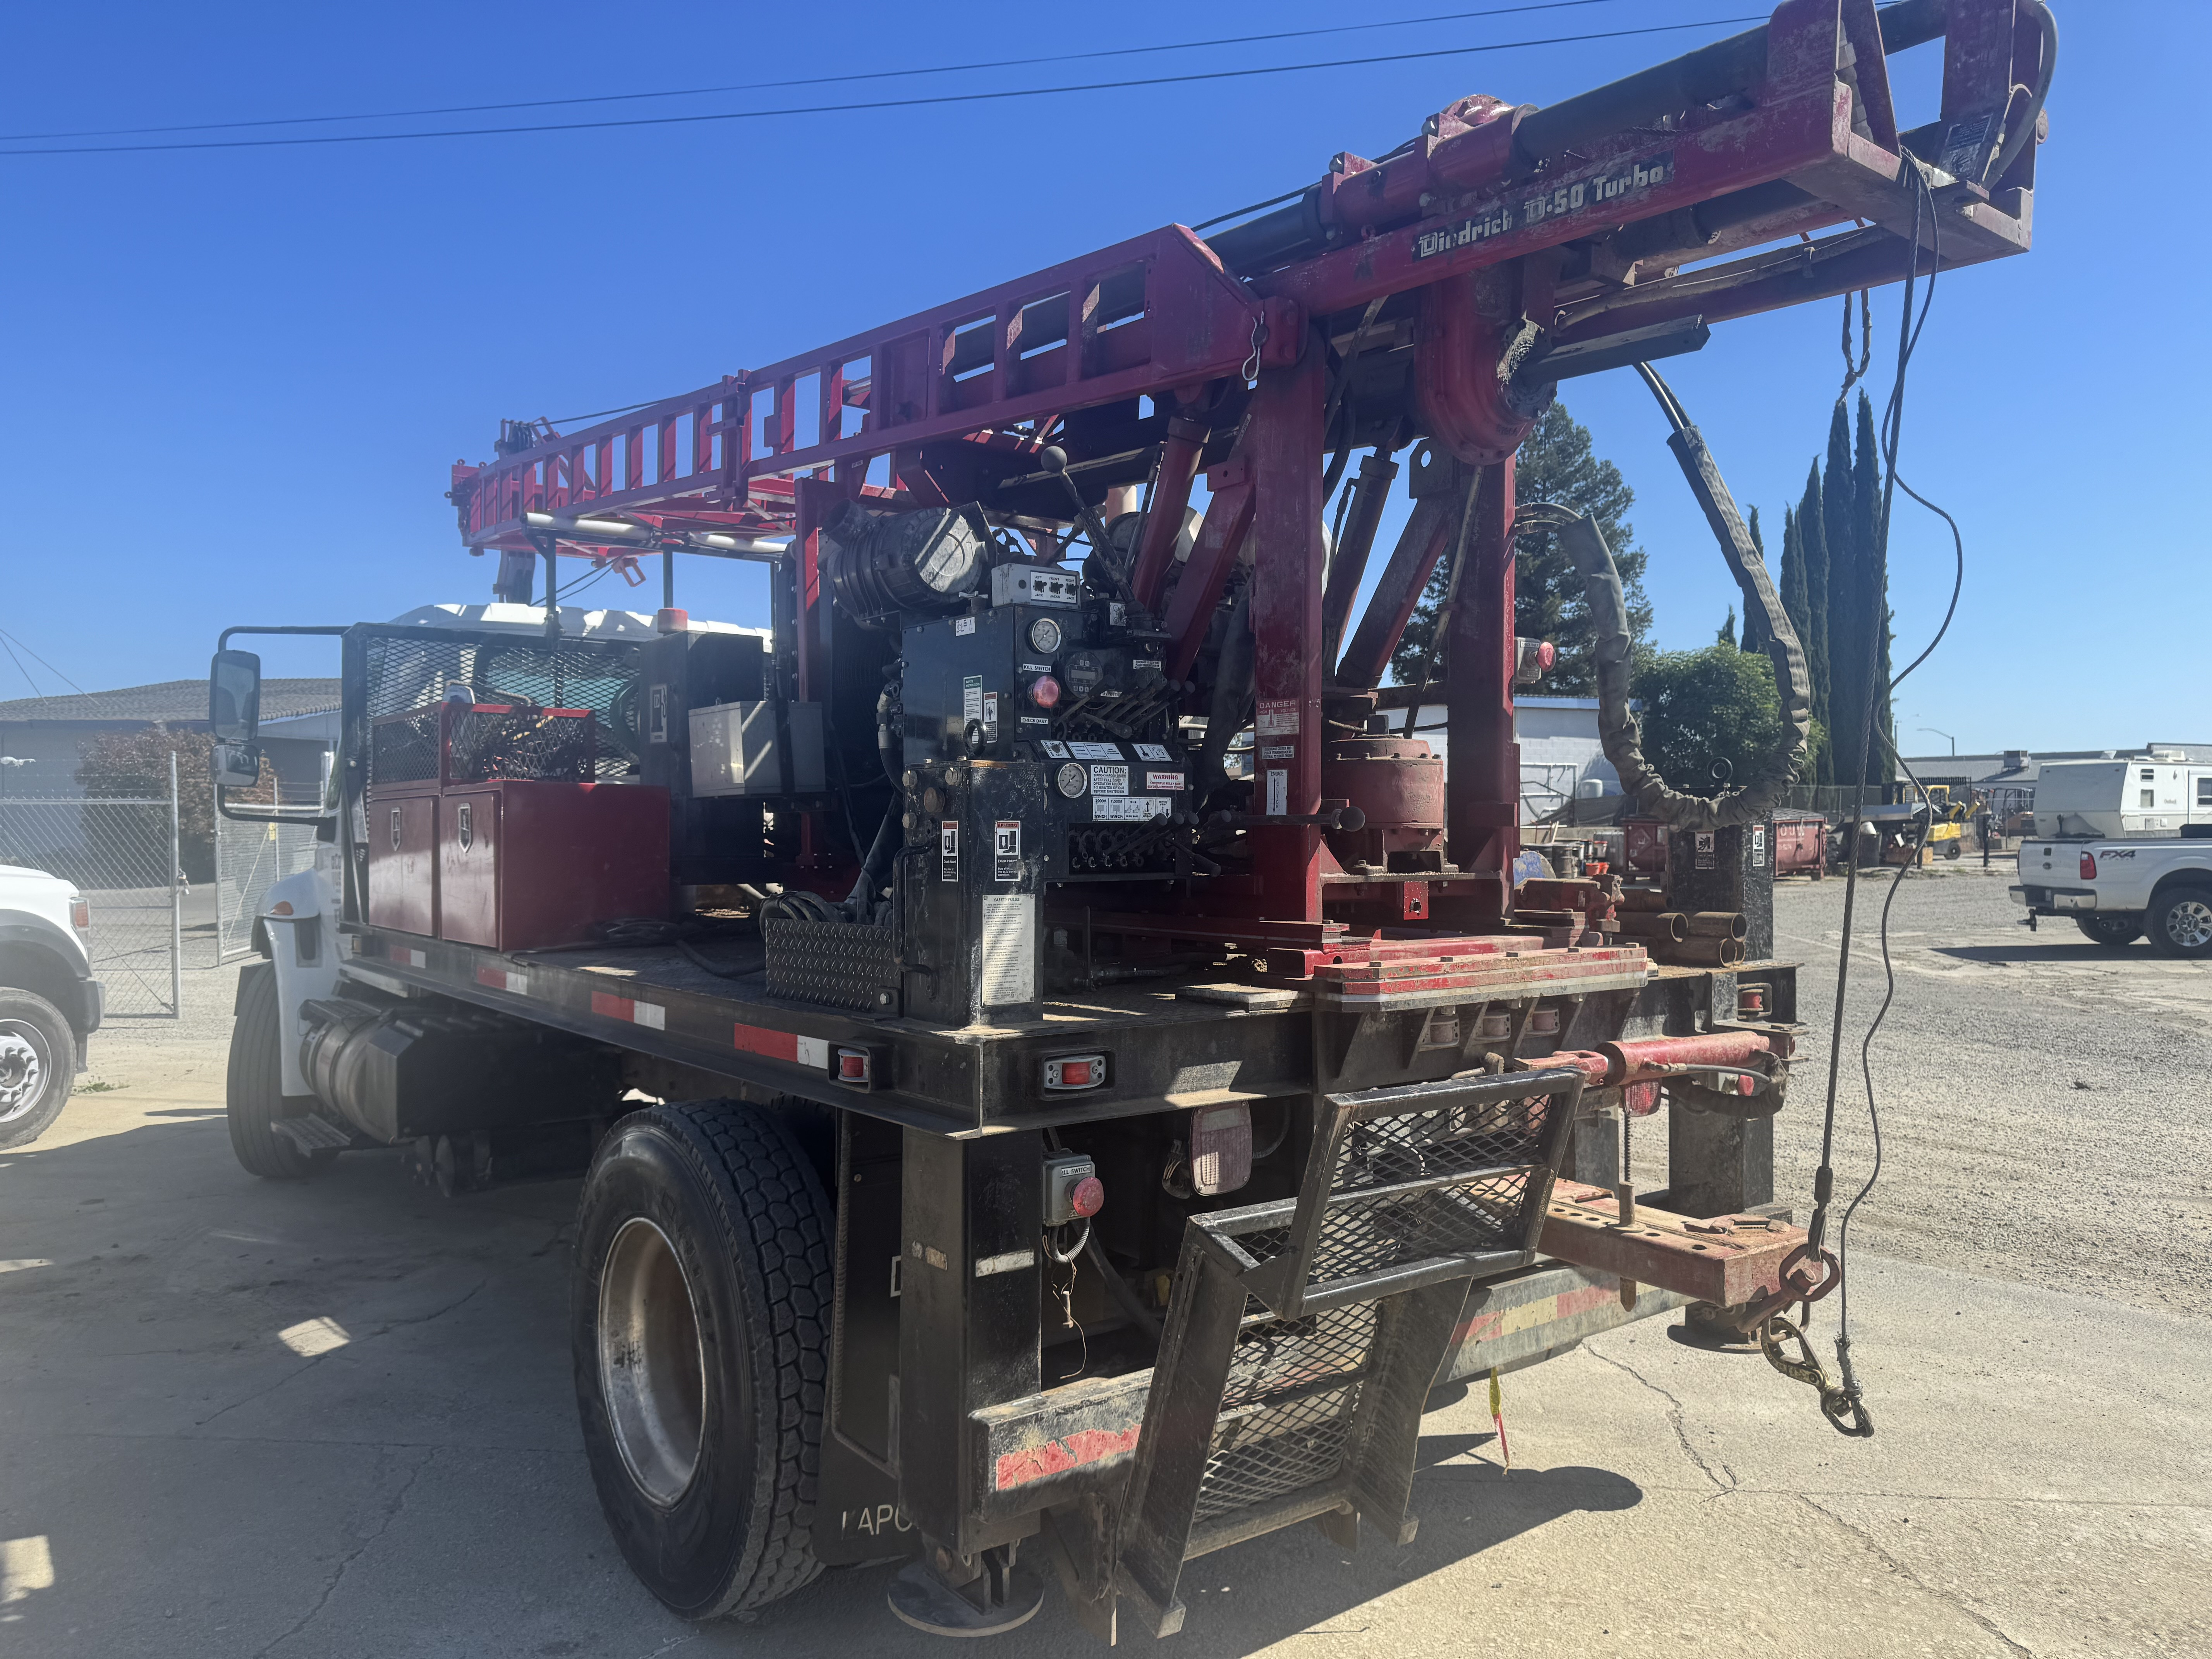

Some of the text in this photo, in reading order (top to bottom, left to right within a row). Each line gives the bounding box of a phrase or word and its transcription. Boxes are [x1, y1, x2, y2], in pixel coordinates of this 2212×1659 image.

[1593, 164, 1664, 201] Turbo
[1259, 700, 1296, 709] DANGER
[2099, 850, 2136, 859] FX4
